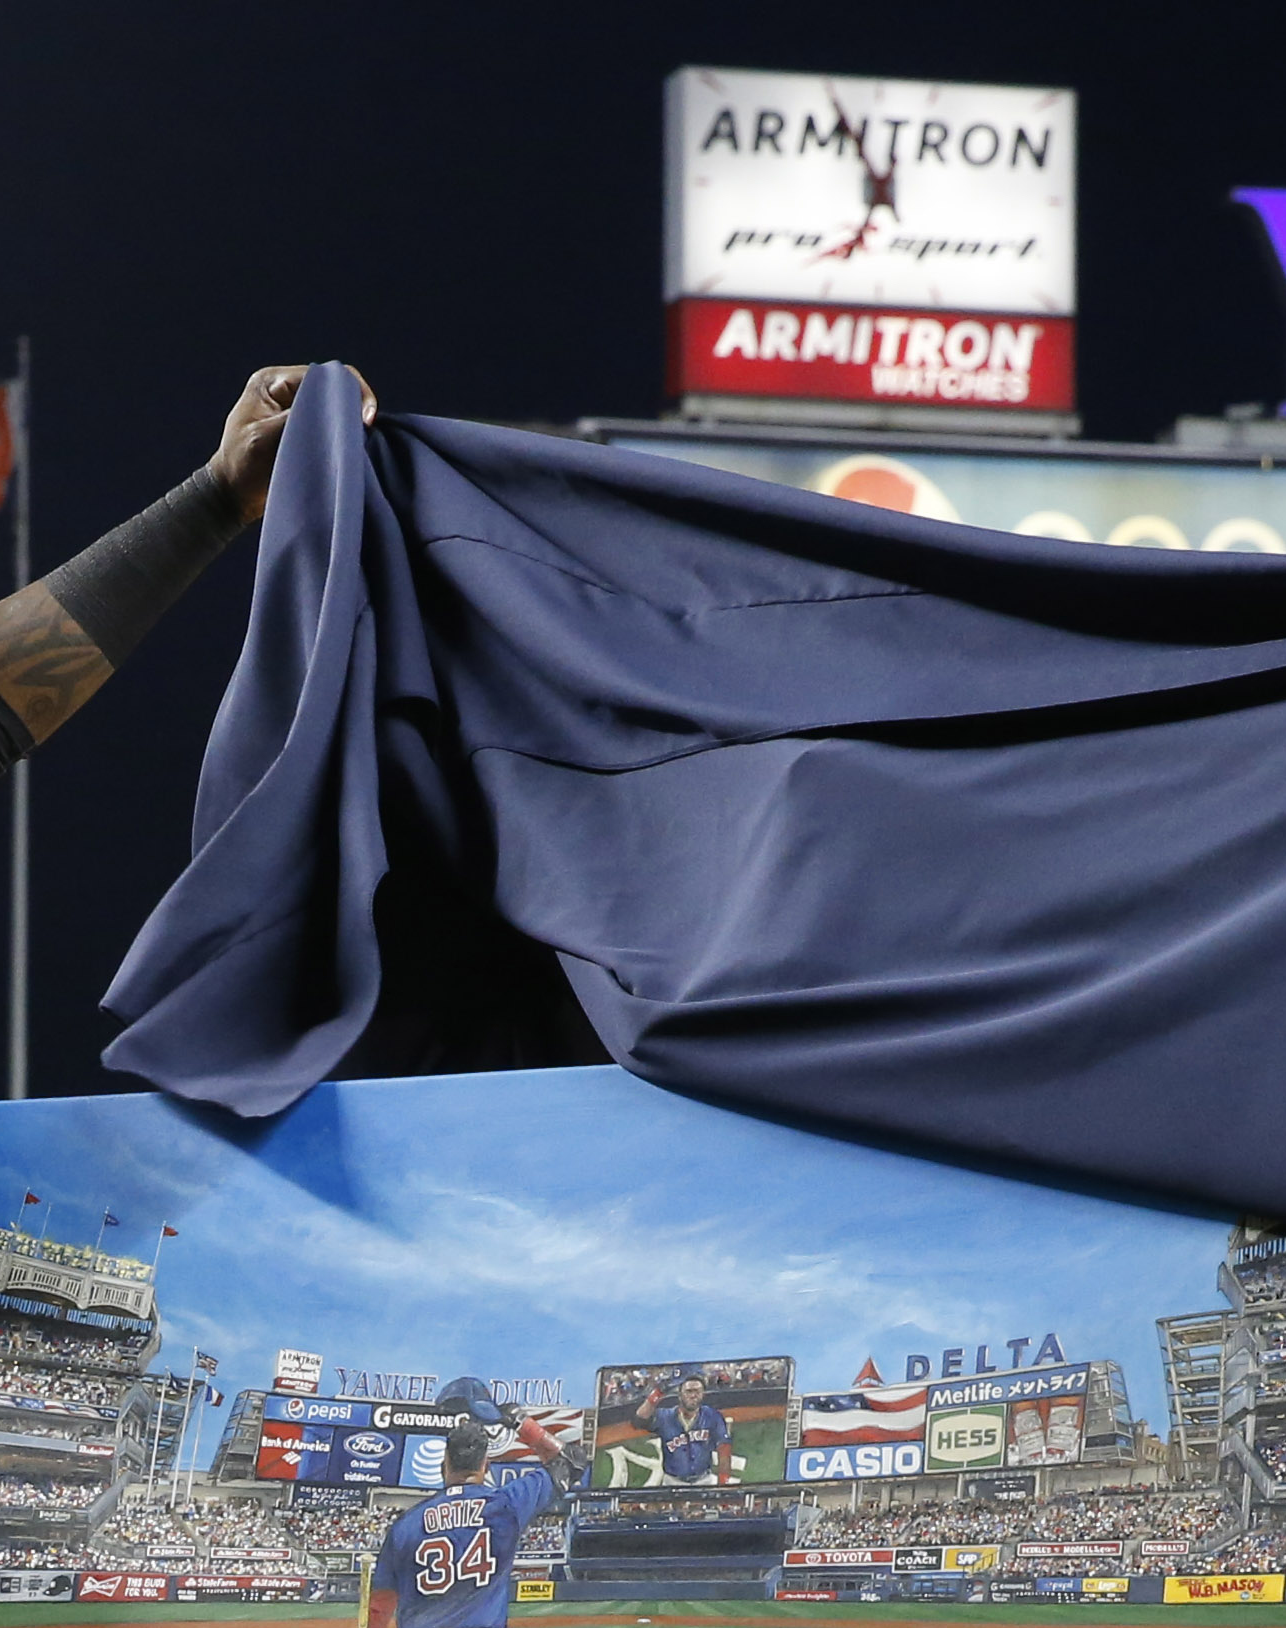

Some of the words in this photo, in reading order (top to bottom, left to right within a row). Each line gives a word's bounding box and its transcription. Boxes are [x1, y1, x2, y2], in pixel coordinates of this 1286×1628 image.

[701, 107, 1052, 171] ARMITRON
[713, 307, 1038, 374] ARMITRON
[871, 363, 1031, 402] WATCHES
[905, 1333, 1066, 1382] DELTA
[334, 1366, 439, 1402] YANKEE
[307, 1404, 352, 1420] pepsi
[392, 1411, 455, 1428] GATORADE
[352, 1436, 385, 1453] Ford
[937, 1428, 998, 1450] HESS
[798, 1444, 921, 1479] CASIO
[423, 1499, 486, 1534] ORTIZ
[415, 1527, 496, 1596] 34
[824, 1551, 873, 1563] TOYOTA
[896, 1556, 938, 1567] COACH
